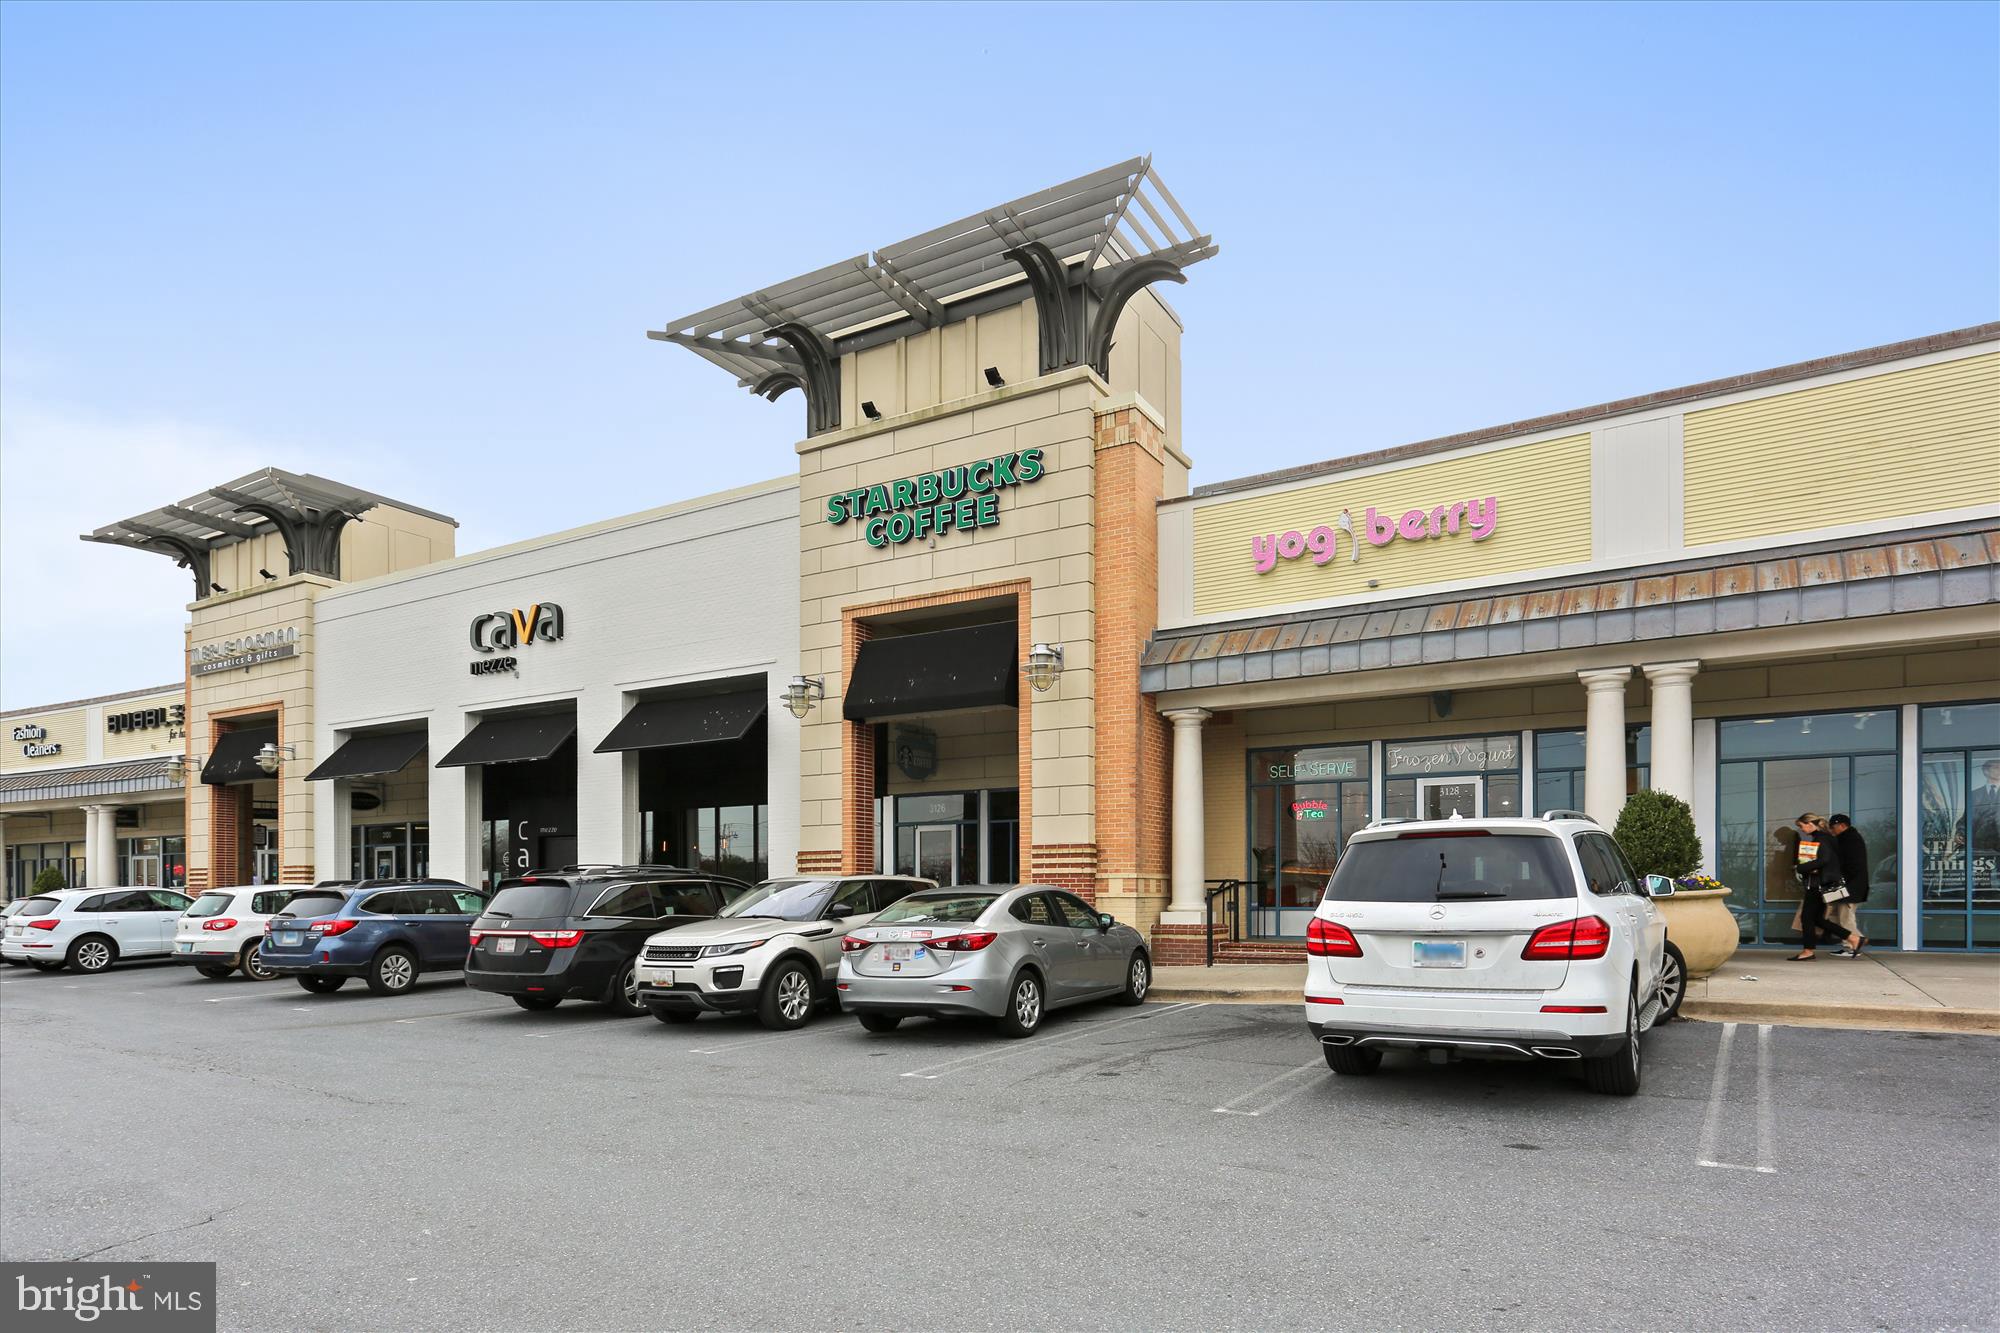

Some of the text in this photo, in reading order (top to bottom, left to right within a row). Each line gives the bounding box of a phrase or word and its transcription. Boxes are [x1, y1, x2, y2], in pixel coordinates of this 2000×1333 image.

[827, 449, 1044, 524] STARBUCKS
[865, 494, 999, 547] COFFEE
[203, 658, 244, 671] cosmetics
[256, 650, 278, 663] gifts
[470, 656, 517, 675] mezze
[12, 724, 43, 741] Fashion
[23, 743, 59, 758] Cleaners
[1388, 744, 1515, 772] Frozen Yogurt
[1292, 800, 1328, 811] Bubble
[1304, 809, 1324, 818] Tea
